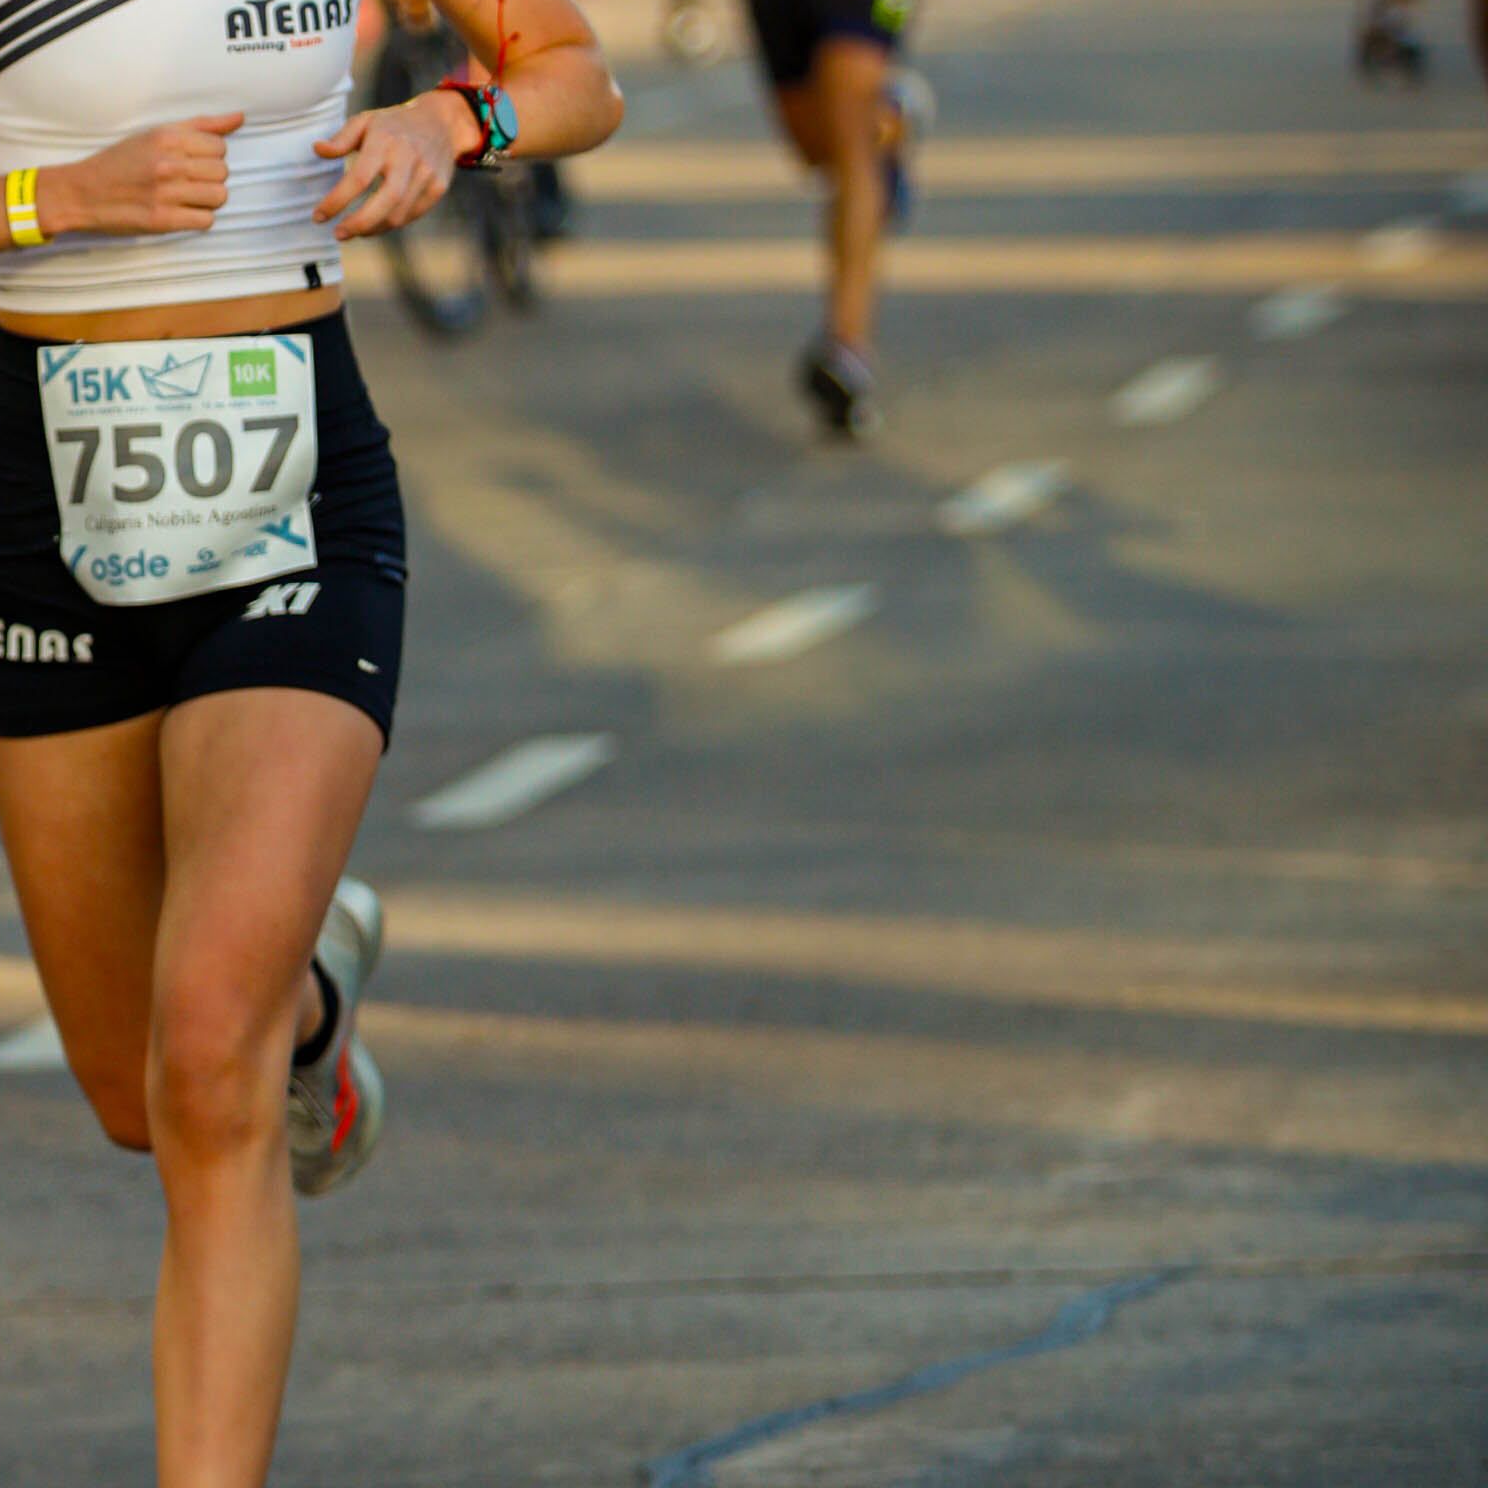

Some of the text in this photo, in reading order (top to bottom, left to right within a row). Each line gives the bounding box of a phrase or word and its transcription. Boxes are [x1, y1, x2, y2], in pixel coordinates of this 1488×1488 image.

[226, 36, 323, 53] running team
[65, 366, 132, 405] 15K
[233, 361, 272, 385] 10K
[56, 414, 300, 505] 7507
[91, 549, 169, 586] osde
